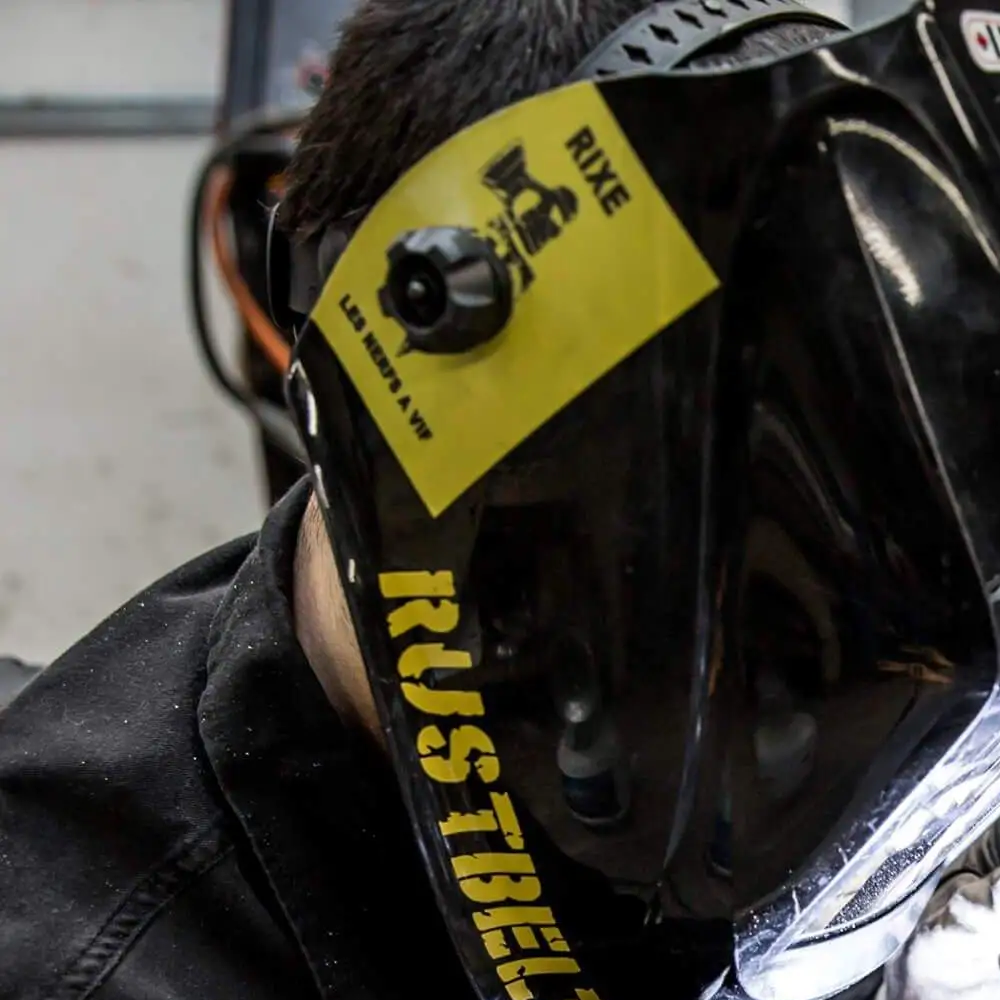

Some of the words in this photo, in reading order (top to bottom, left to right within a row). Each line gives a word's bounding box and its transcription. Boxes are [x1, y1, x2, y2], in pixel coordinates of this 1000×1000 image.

[564, 125, 632, 217] RIXE
[338, 293, 366, 333] LES
[361, 333, 402, 395] NERFS
[396, 395, 412, 413] A
[408, 411, 434, 442] VIF
